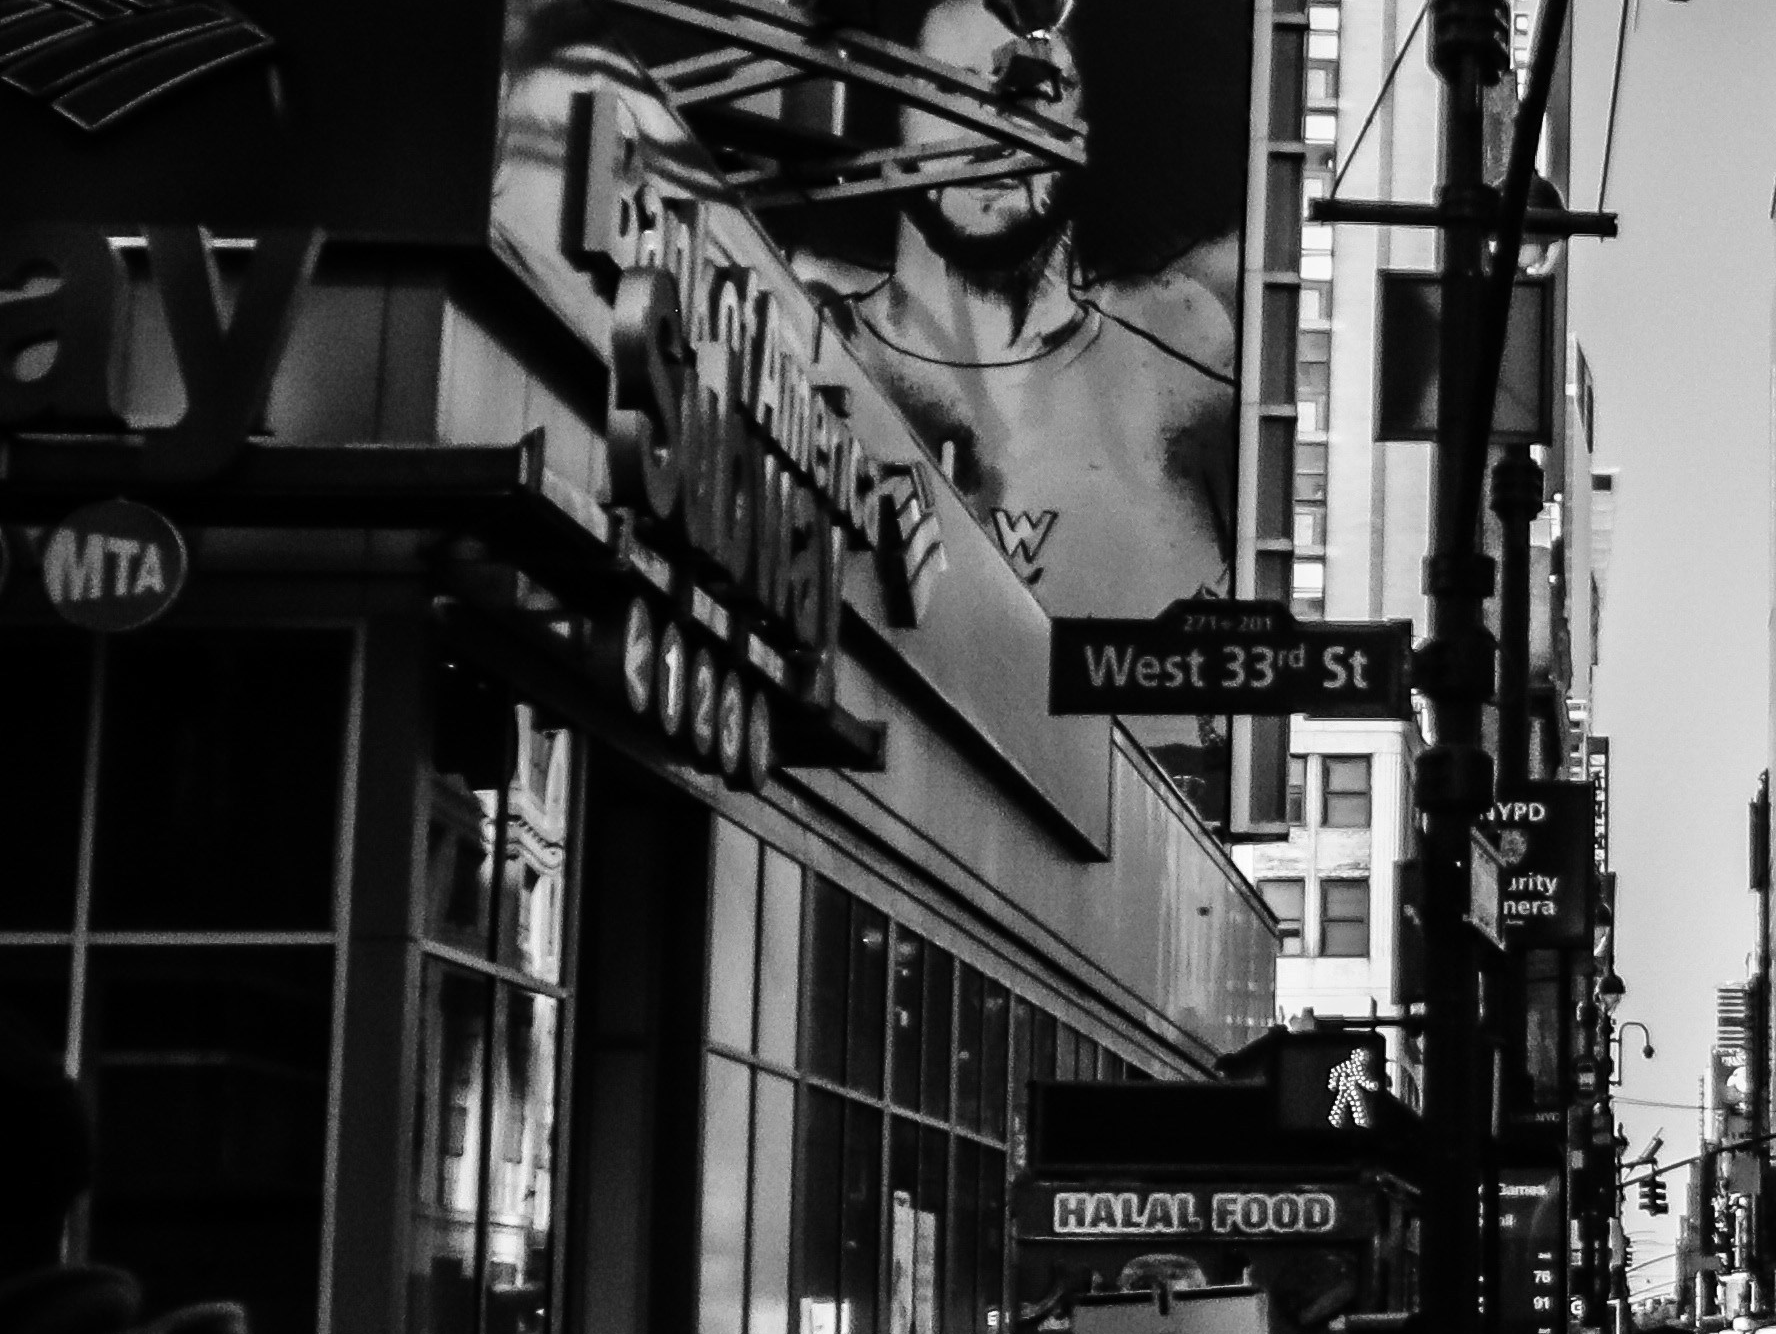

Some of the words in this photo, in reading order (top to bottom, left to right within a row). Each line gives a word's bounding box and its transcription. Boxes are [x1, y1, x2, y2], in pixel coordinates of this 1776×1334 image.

[45, 525, 166, 604] MTA
[1082, 643, 1207, 689] West
[1220, 642, 1307, 690] 33rd
[1322, 645, 1370, 690] St
[1053, 1191, 1203, 1235] HALAL
[1211, 1191, 1337, 1235] FOOD
